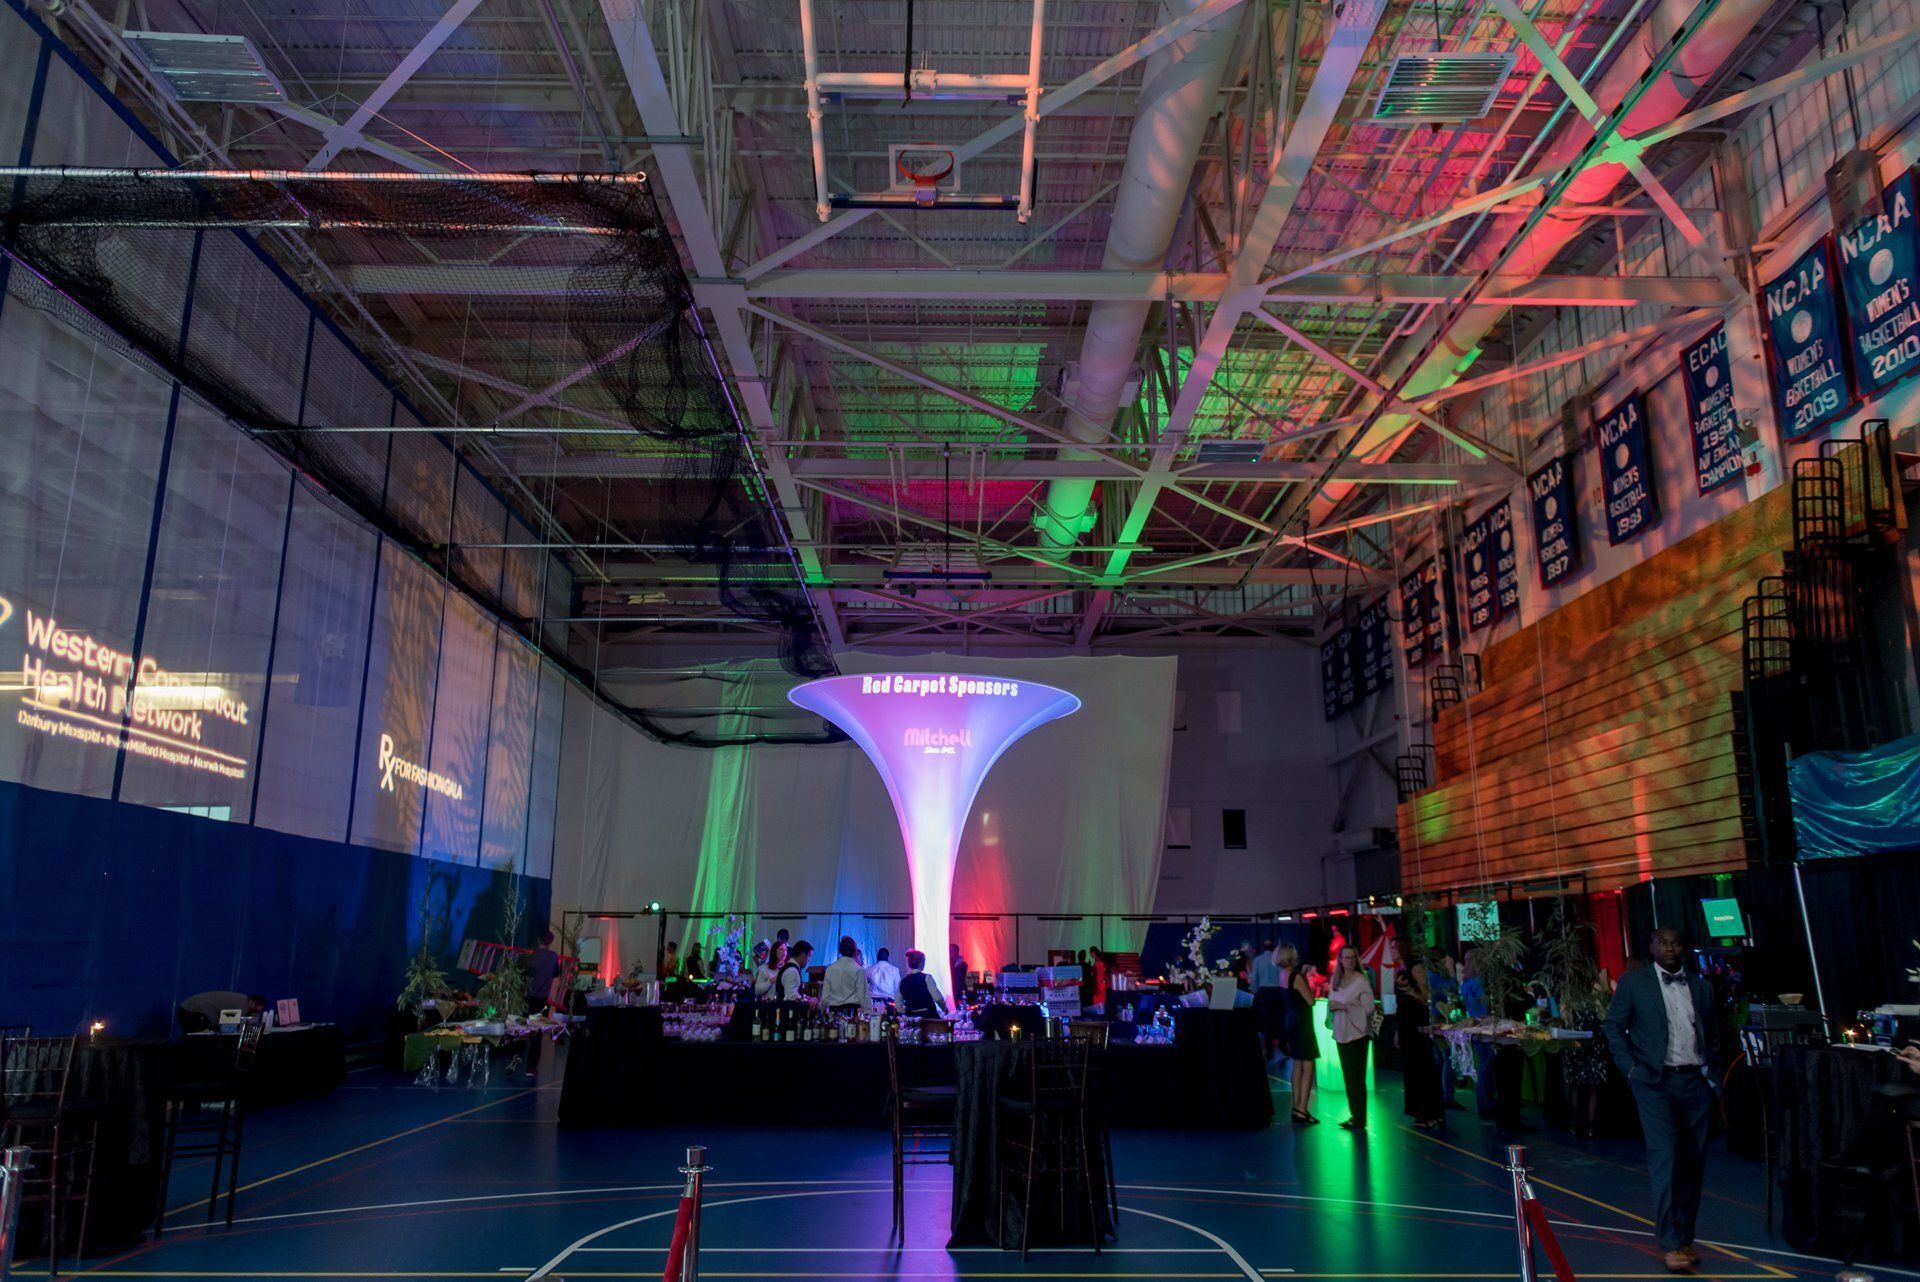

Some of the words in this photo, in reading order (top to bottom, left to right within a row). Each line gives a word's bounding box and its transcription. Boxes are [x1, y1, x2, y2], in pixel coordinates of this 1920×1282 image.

[1840, 190, 1911, 264] NCAA
[1766, 257, 1825, 320] NCAA
[1866, 278, 1909, 322] WOMEN'S
[1787, 338, 1824, 377] WOMEN'S
[1871, 335, 1920, 380] 2010
[1599, 403, 1638, 449] NCAA
[1794, 388, 1839, 431] 2009
[1532, 462, 1563, 501] NCAA
[27, 609, 135, 679] Western
[138, 659, 249, 725] Conicut
[862, 676, 891, 694] Red
[894, 675, 946, 697] Carpet
[949, 675, 1018, 697] Sponsors
[23, 653, 107, 711] Health
[112, 685, 202, 740] Network
[130, 740, 159, 758] Milford
[159, 747, 190, 766] Hospital
[904, 727, 972, 747] Mitchell
[395, 756, 412, 780] FOR
[443, 776, 463, 801] GALA
